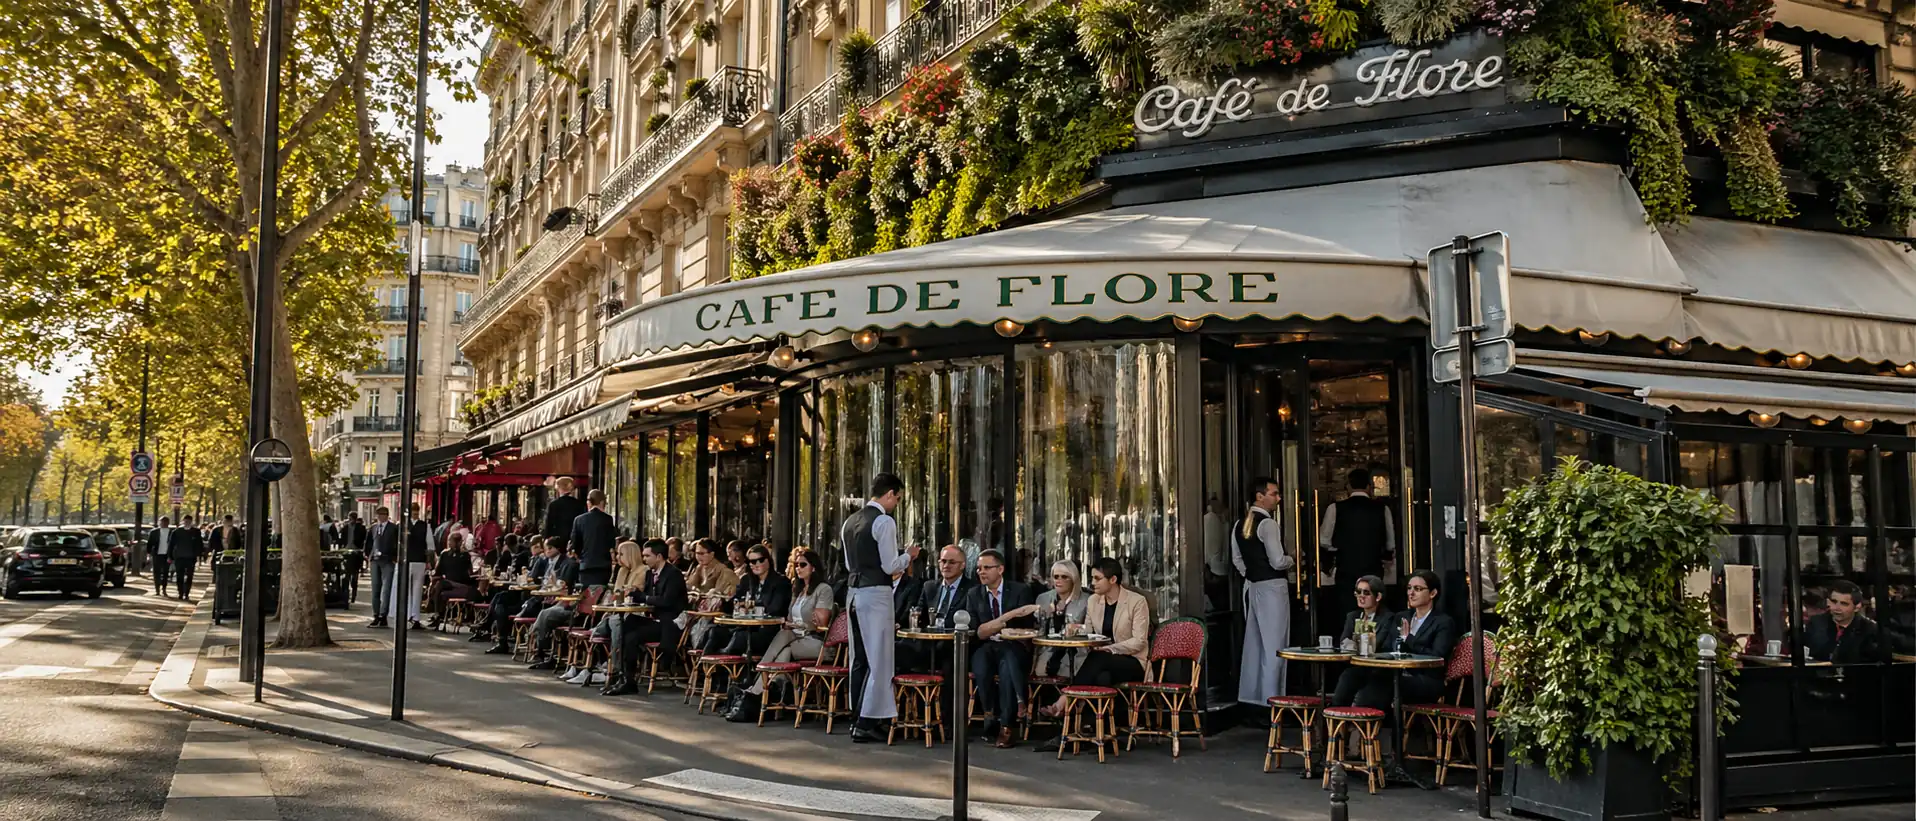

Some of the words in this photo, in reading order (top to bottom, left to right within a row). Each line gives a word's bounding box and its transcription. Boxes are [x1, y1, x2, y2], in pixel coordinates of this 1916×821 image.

[1134, 77, 1257, 138] Café
[1276, 78, 1330, 115] de
[1354, 49, 1504, 107] Flore
[695, 289, 838, 331] CAFE
[866, 279, 961, 315] DE
[996, 272, 1279, 307] FLORE
